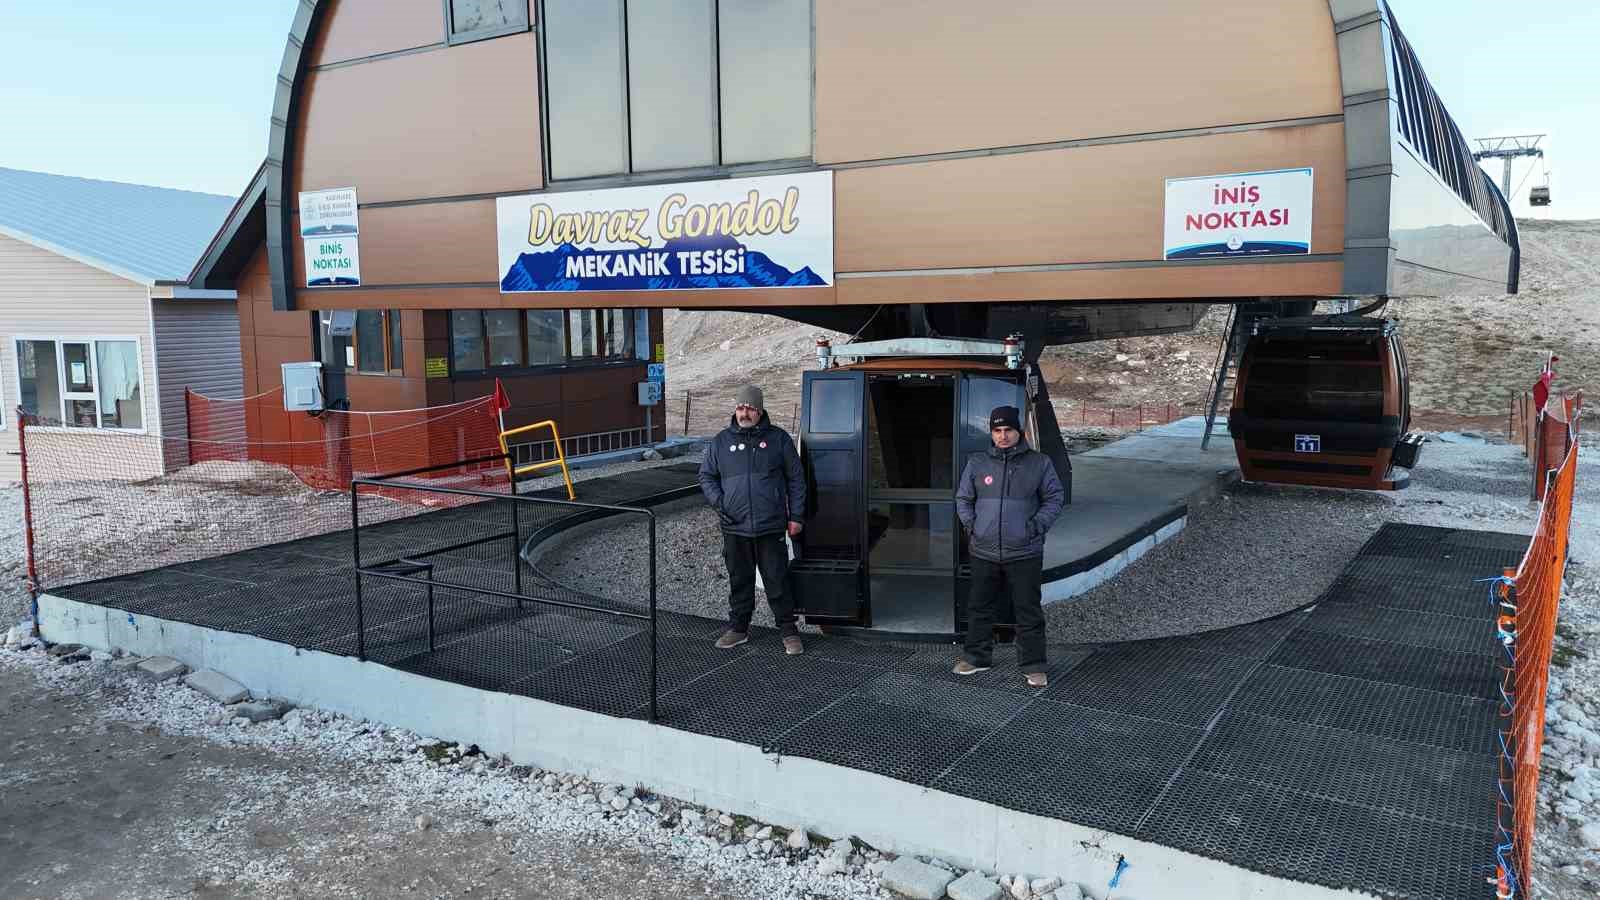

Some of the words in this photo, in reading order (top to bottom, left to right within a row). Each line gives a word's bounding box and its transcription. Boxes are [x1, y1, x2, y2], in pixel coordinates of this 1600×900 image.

[1213, 181, 1260, 207] İNİŞ
[527, 203, 652, 247] Davraz
[658, 186, 799, 240] Gondol
[1185, 208, 1289, 231] NOKTASI
[313, 257, 351, 270] NOKTASI
[565, 251, 670, 278] MEKANİK
[678, 248, 746, 276] TESİSİ
[1300, 442, 1314, 451] 11
